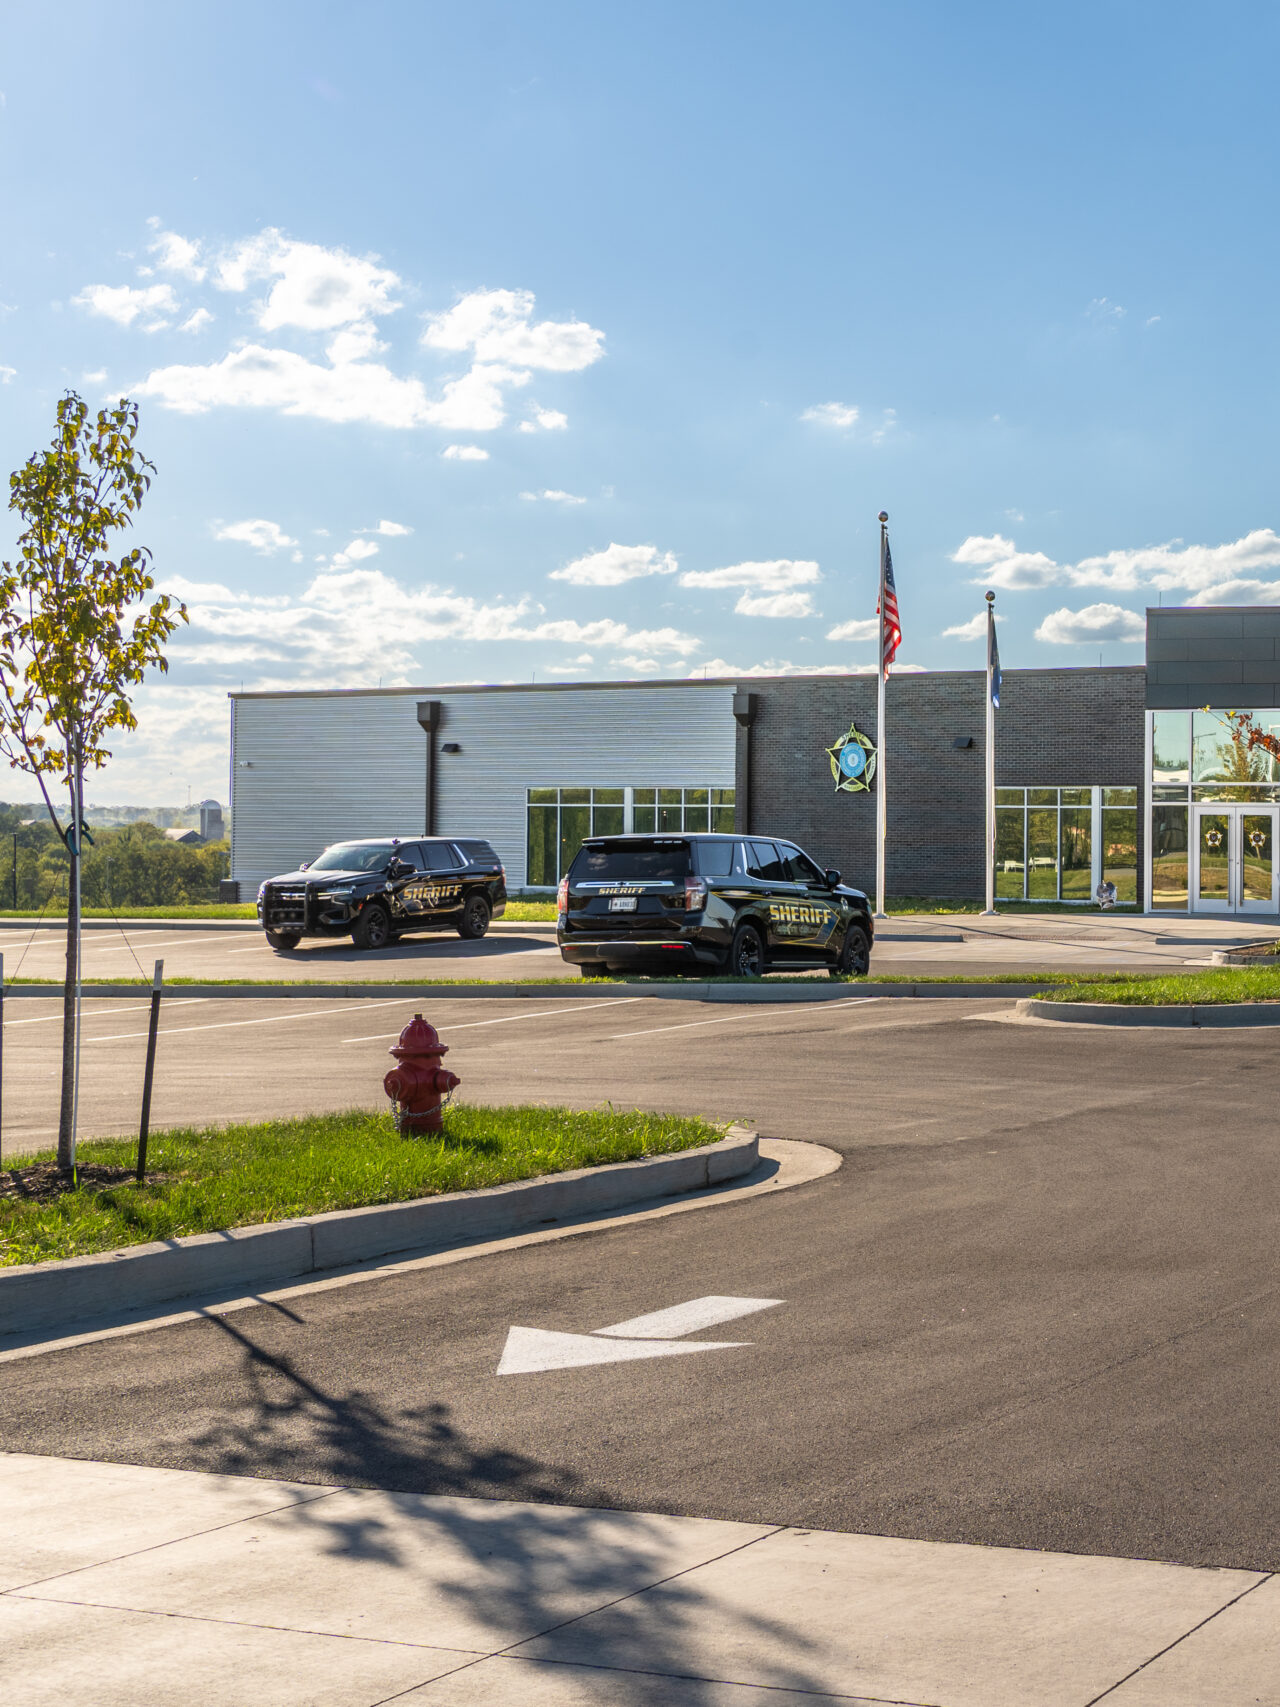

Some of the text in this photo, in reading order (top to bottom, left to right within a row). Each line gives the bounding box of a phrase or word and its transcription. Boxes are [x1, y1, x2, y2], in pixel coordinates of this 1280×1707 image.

[403, 885, 462, 900] SHERIFF
[599, 887, 646, 895] SHERIFF
[769, 904, 832, 925] SHERIFF
